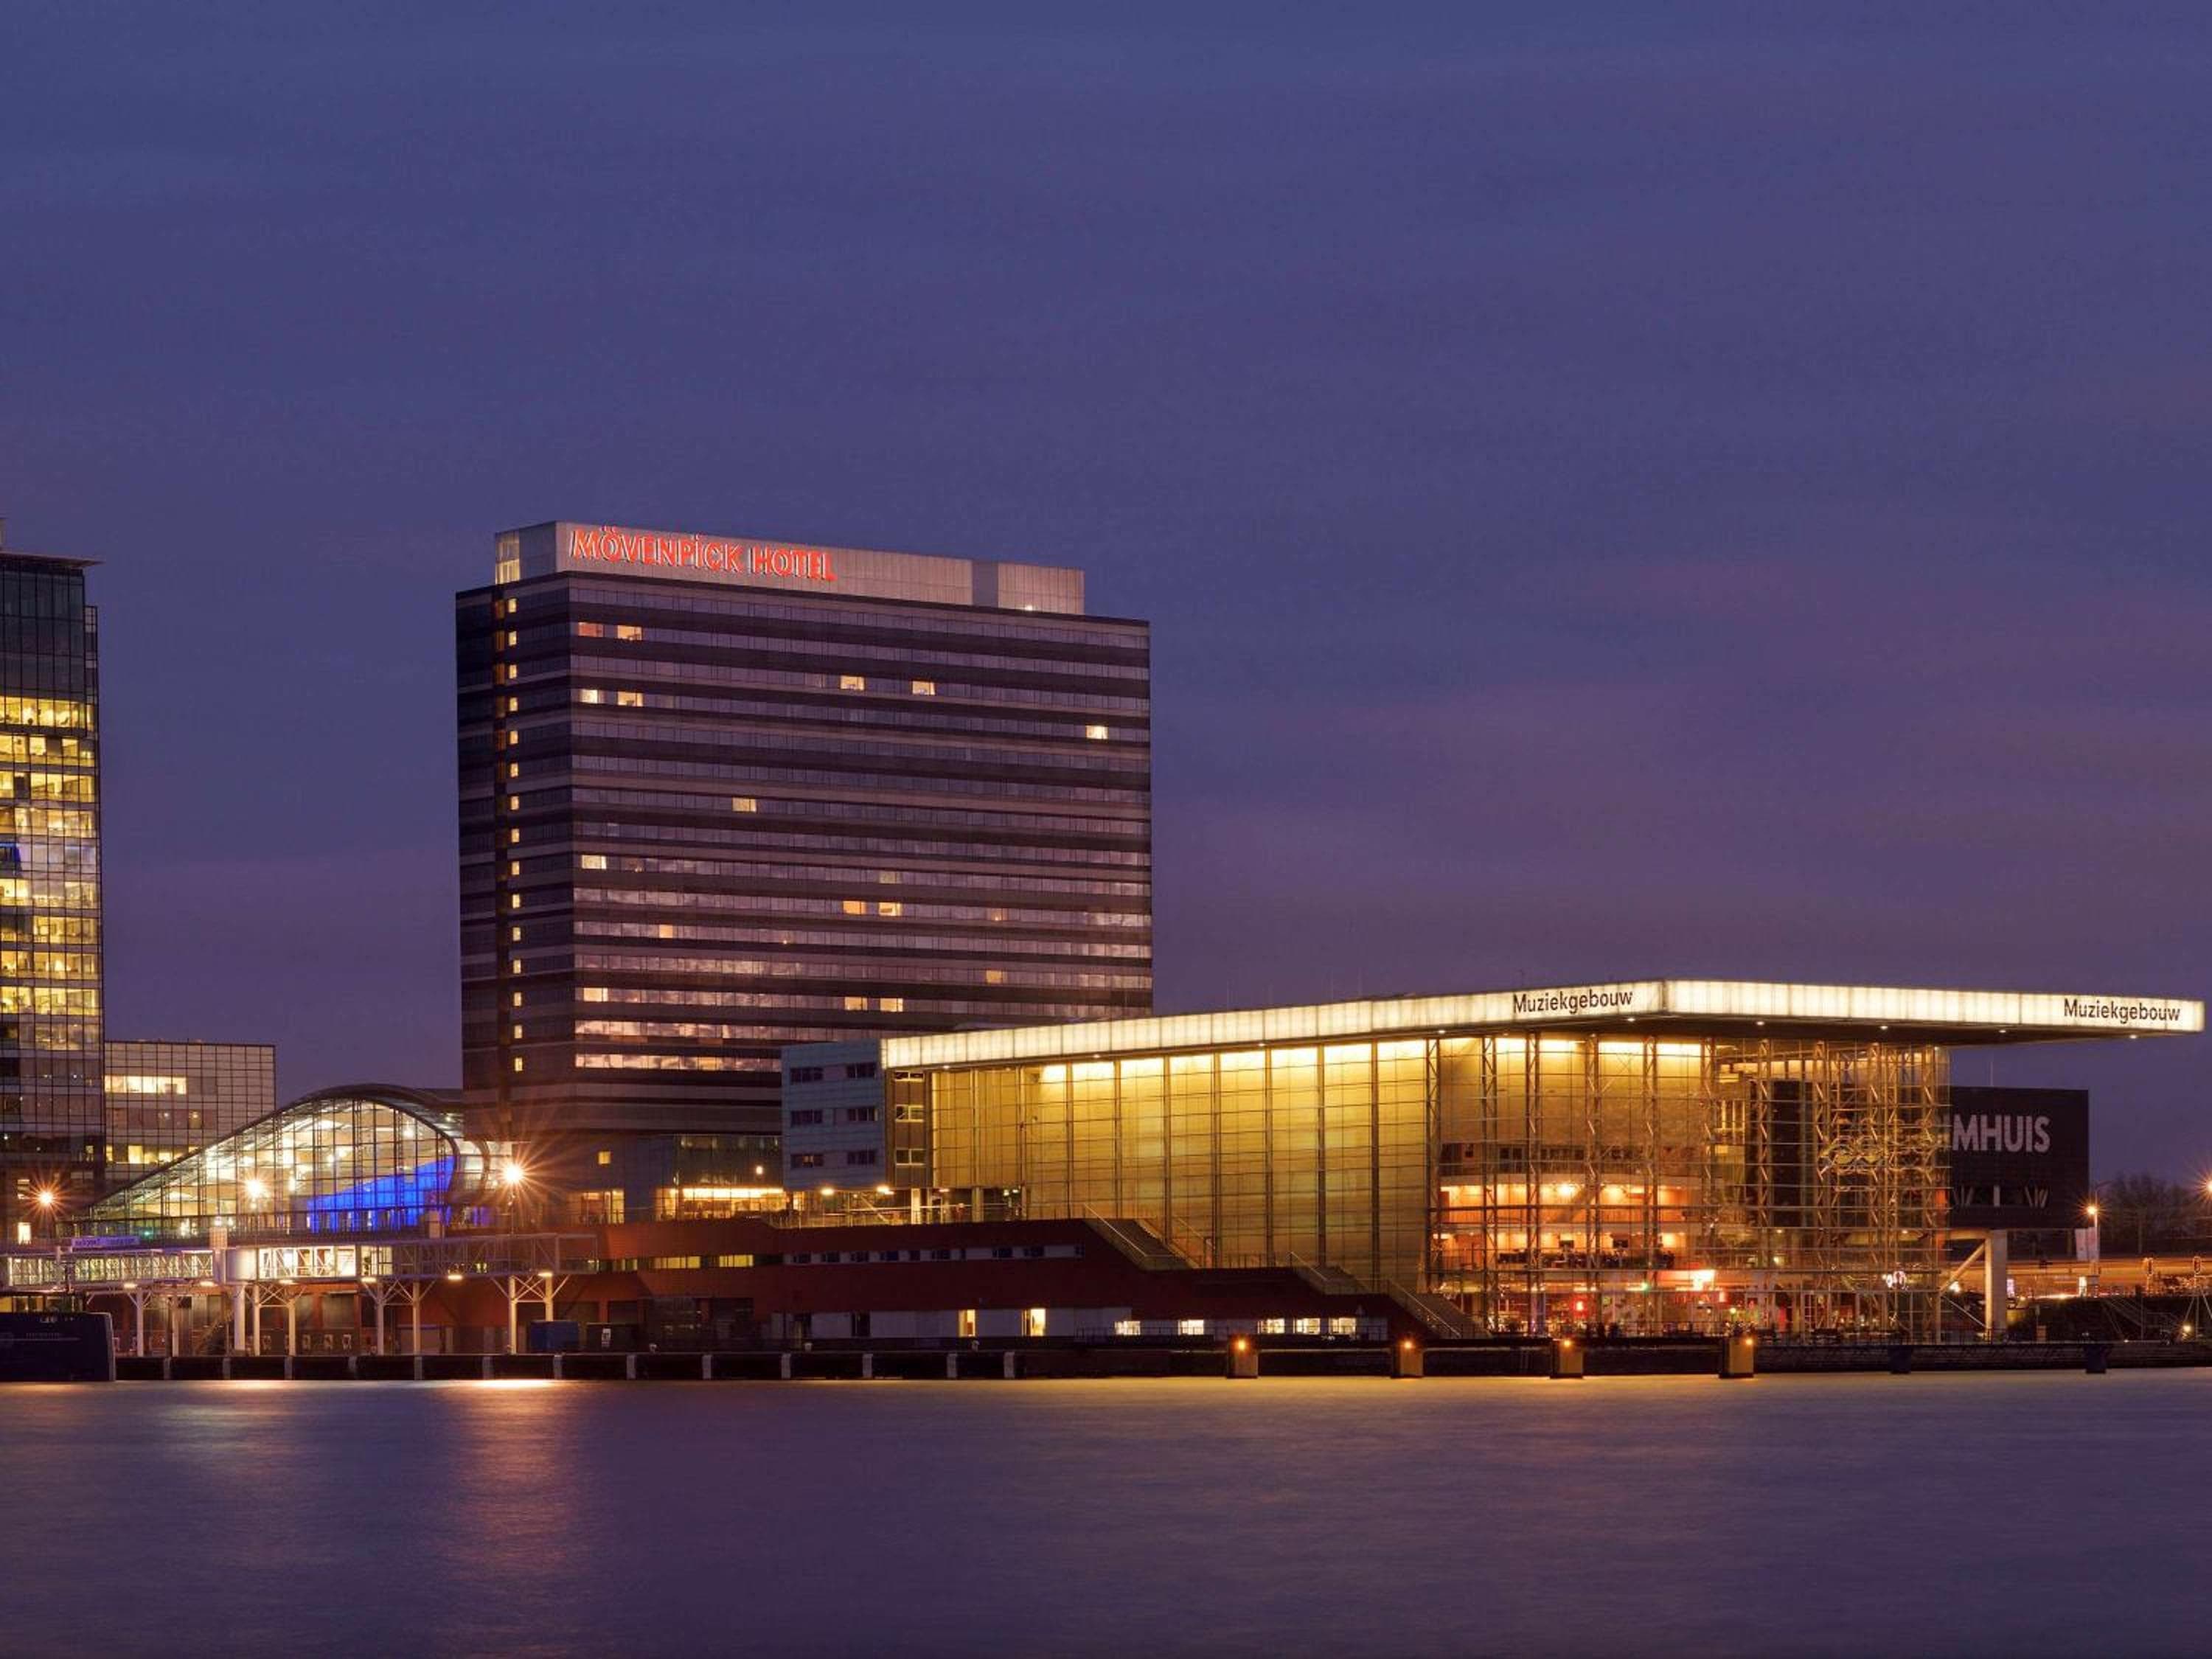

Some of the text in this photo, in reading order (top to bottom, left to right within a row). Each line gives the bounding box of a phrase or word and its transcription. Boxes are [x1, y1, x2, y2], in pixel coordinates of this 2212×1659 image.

[750, 546, 836, 581] HOTEL
[1512, 990, 1633, 1015] Muziekgebouw
[2064, 998, 2180, 1024] Muziekgebouw
